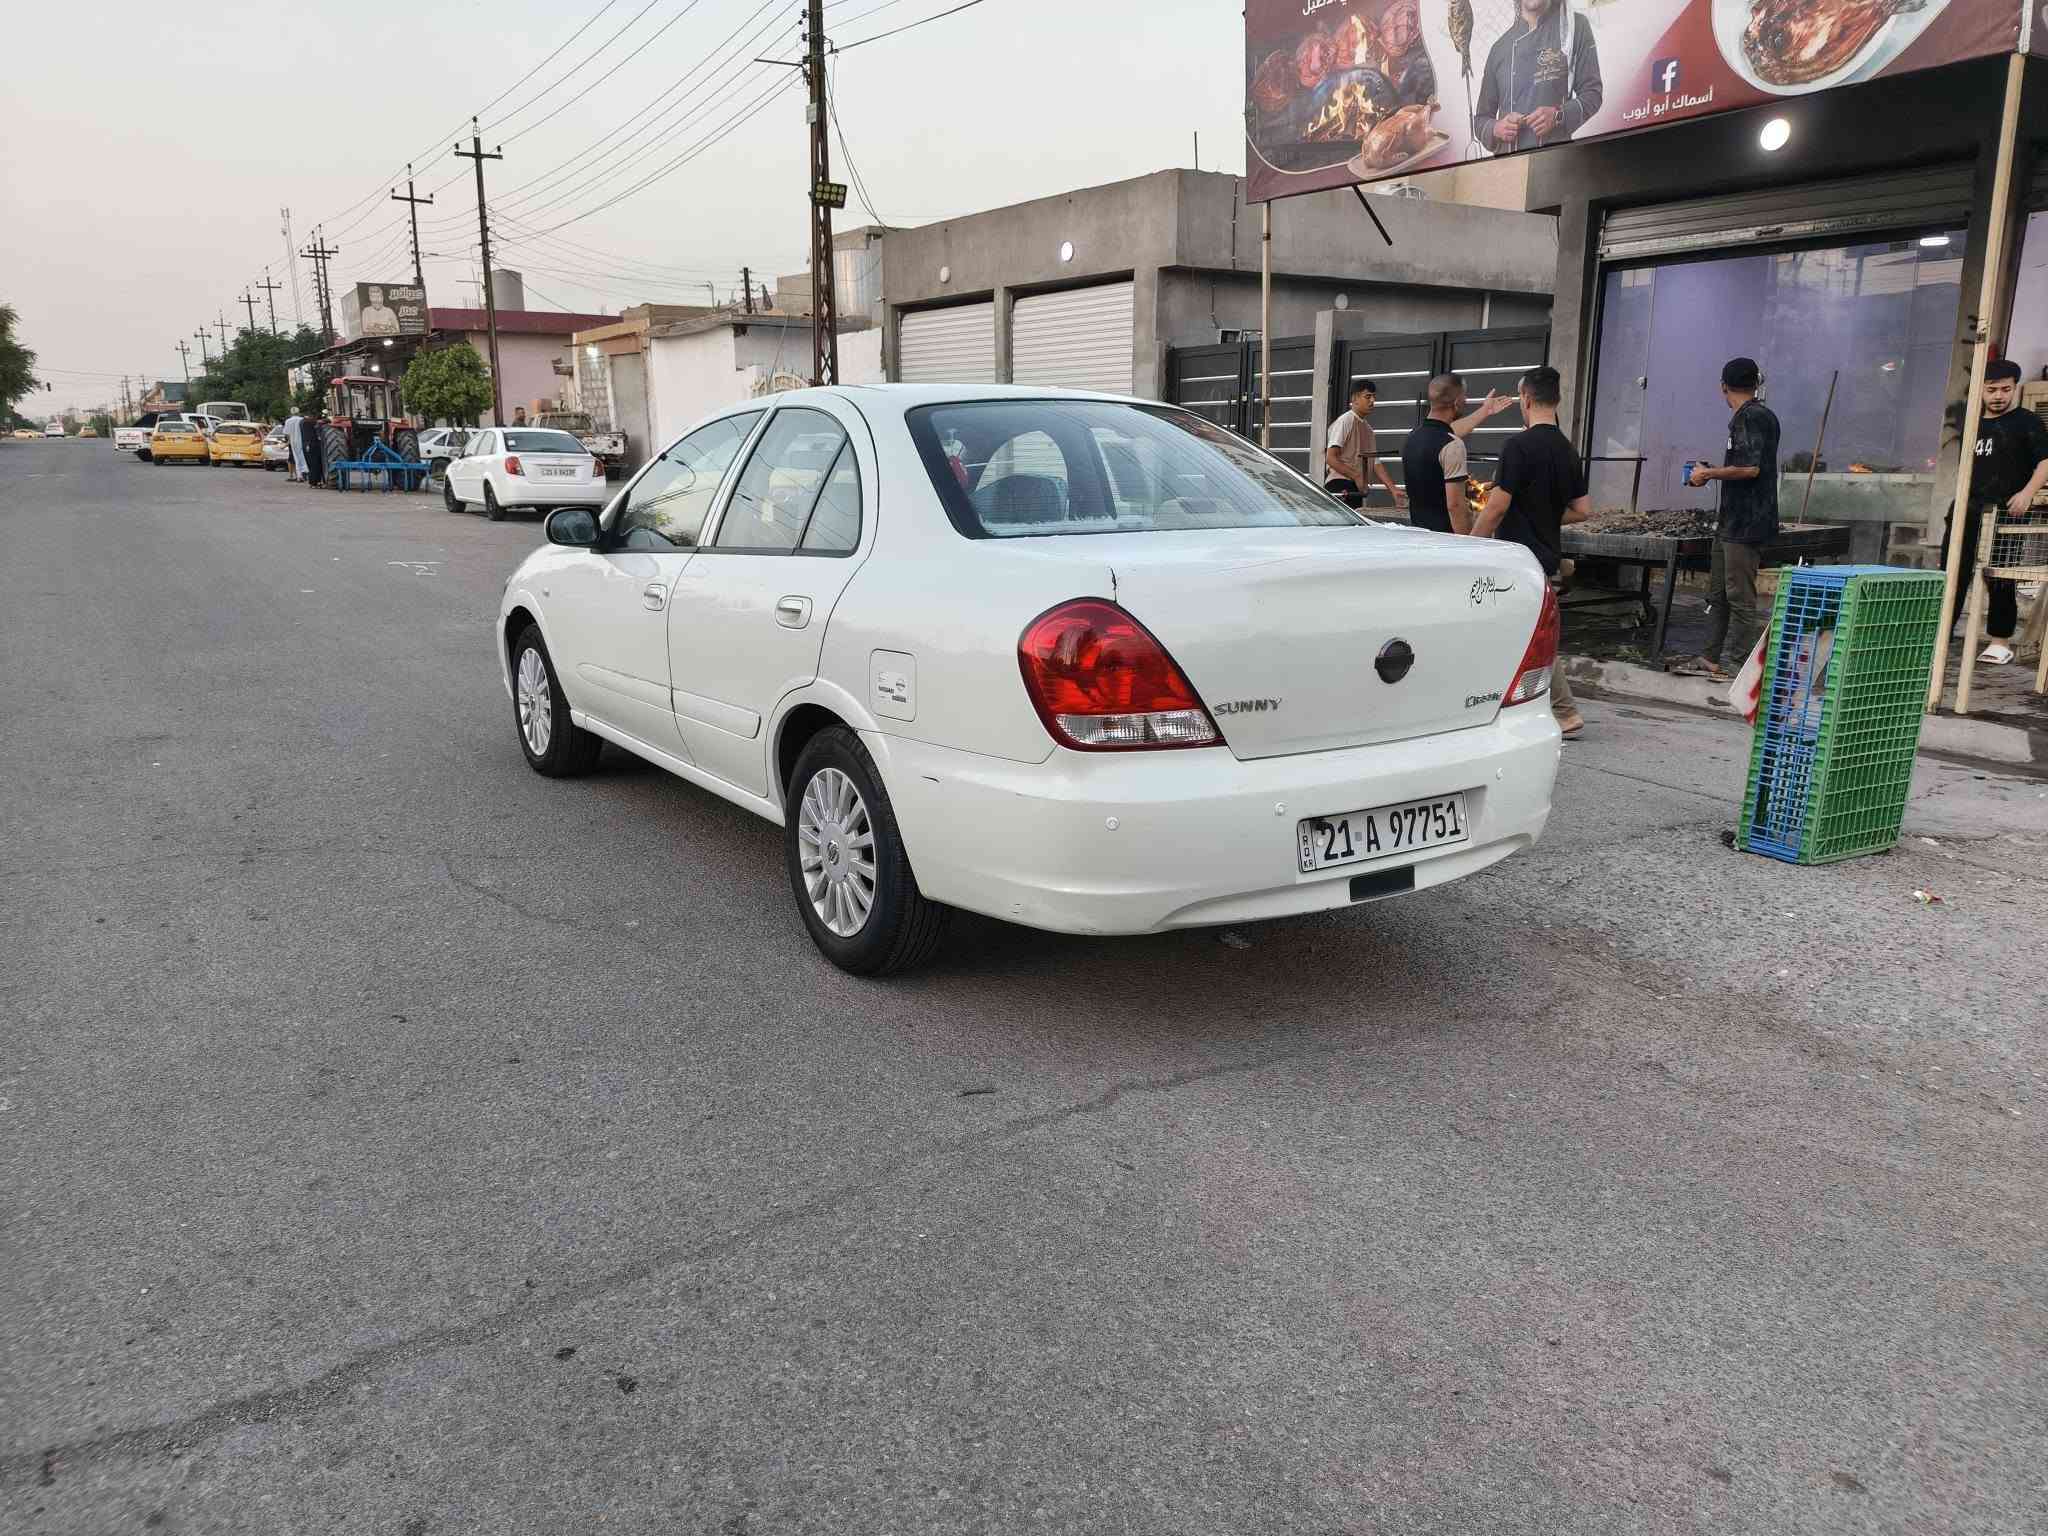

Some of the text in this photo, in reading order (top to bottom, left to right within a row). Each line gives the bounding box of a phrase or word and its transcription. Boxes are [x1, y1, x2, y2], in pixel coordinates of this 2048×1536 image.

[1623, 85, 1713, 121] أسماك أبو أيوب
[1214, 698, 1282, 716] SUNNY
[1323, 801, 1461, 861] 21 A 97751
